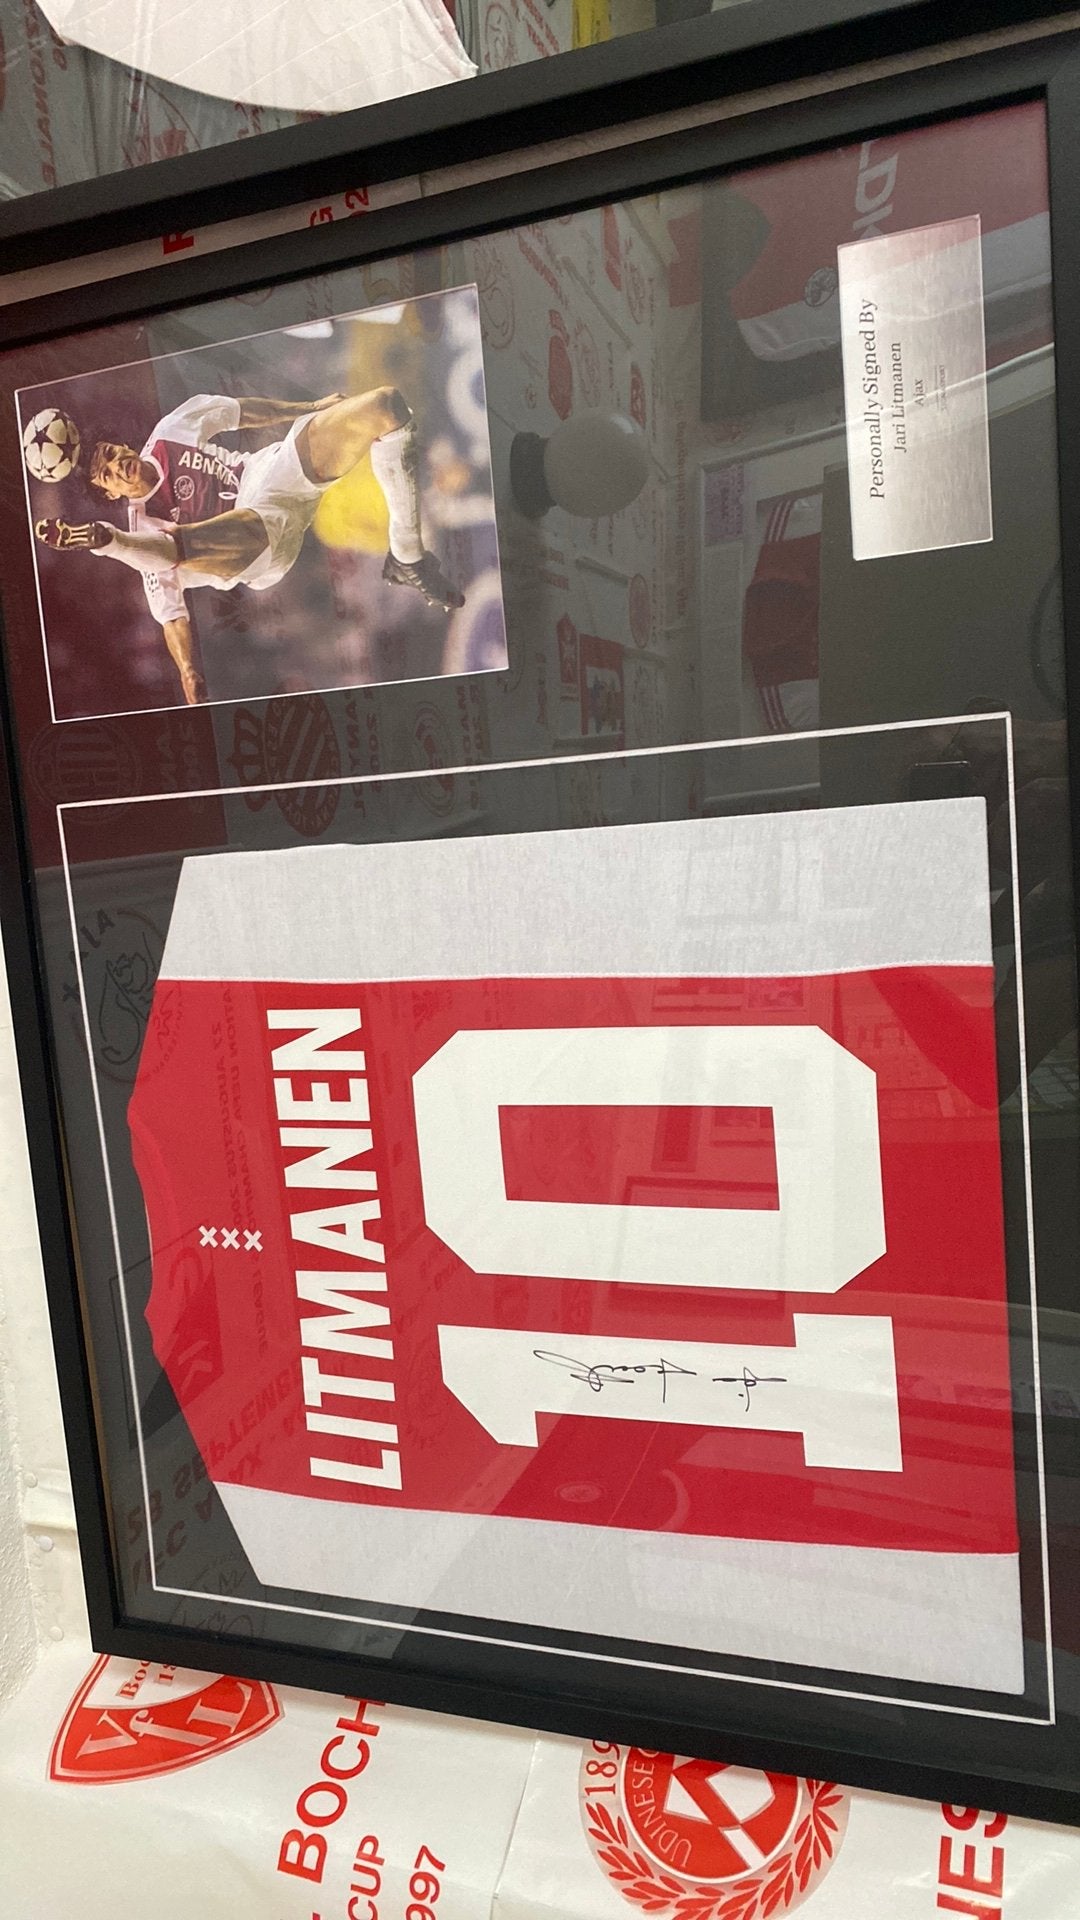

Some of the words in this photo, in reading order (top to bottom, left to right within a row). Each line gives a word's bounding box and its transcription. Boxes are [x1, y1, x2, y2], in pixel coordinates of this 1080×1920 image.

[858, 298, 878, 323] By
[859, 329, 882, 394] Signed
[889, 342, 905, 418] Litmanen
[863, 398, 885, 499] Personally
[892, 423, 907, 453] Jari
[267, 1008, 402, 1490] LITMANEN
[412, 1025, 903, 1472] 10
[348, 1835, 385, 1920] CUP
